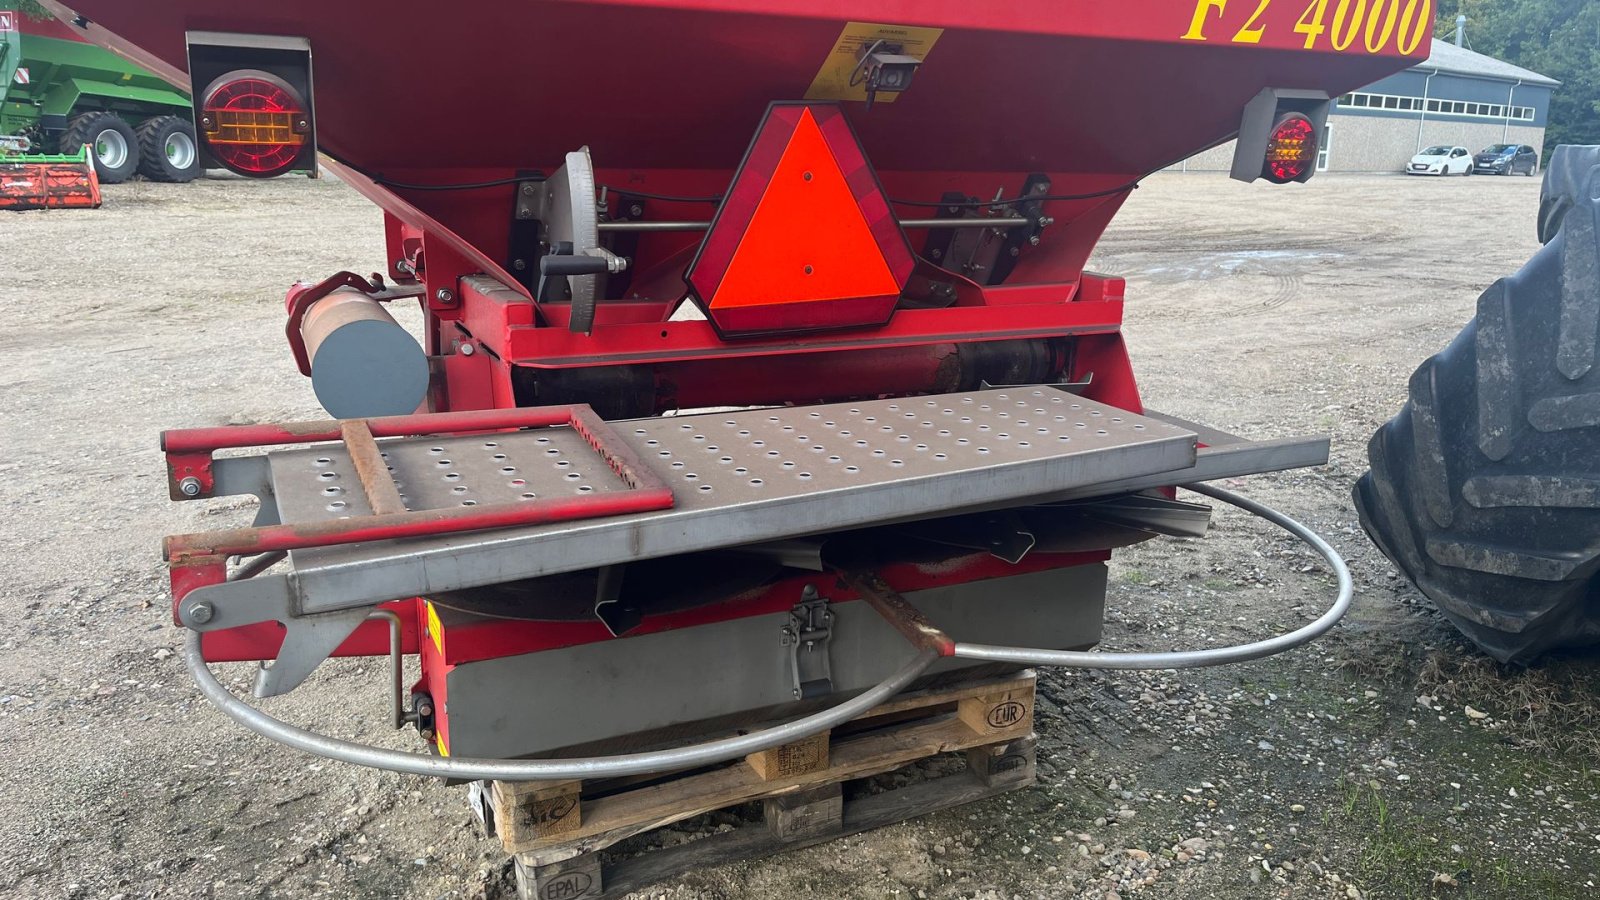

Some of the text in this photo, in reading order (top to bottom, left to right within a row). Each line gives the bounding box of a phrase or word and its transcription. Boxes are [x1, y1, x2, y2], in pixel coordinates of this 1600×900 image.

[1293, 0, 1431, 56] 4000
[995, 705, 1018, 725] EUR
[547, 876, 586, 900] EPAL
